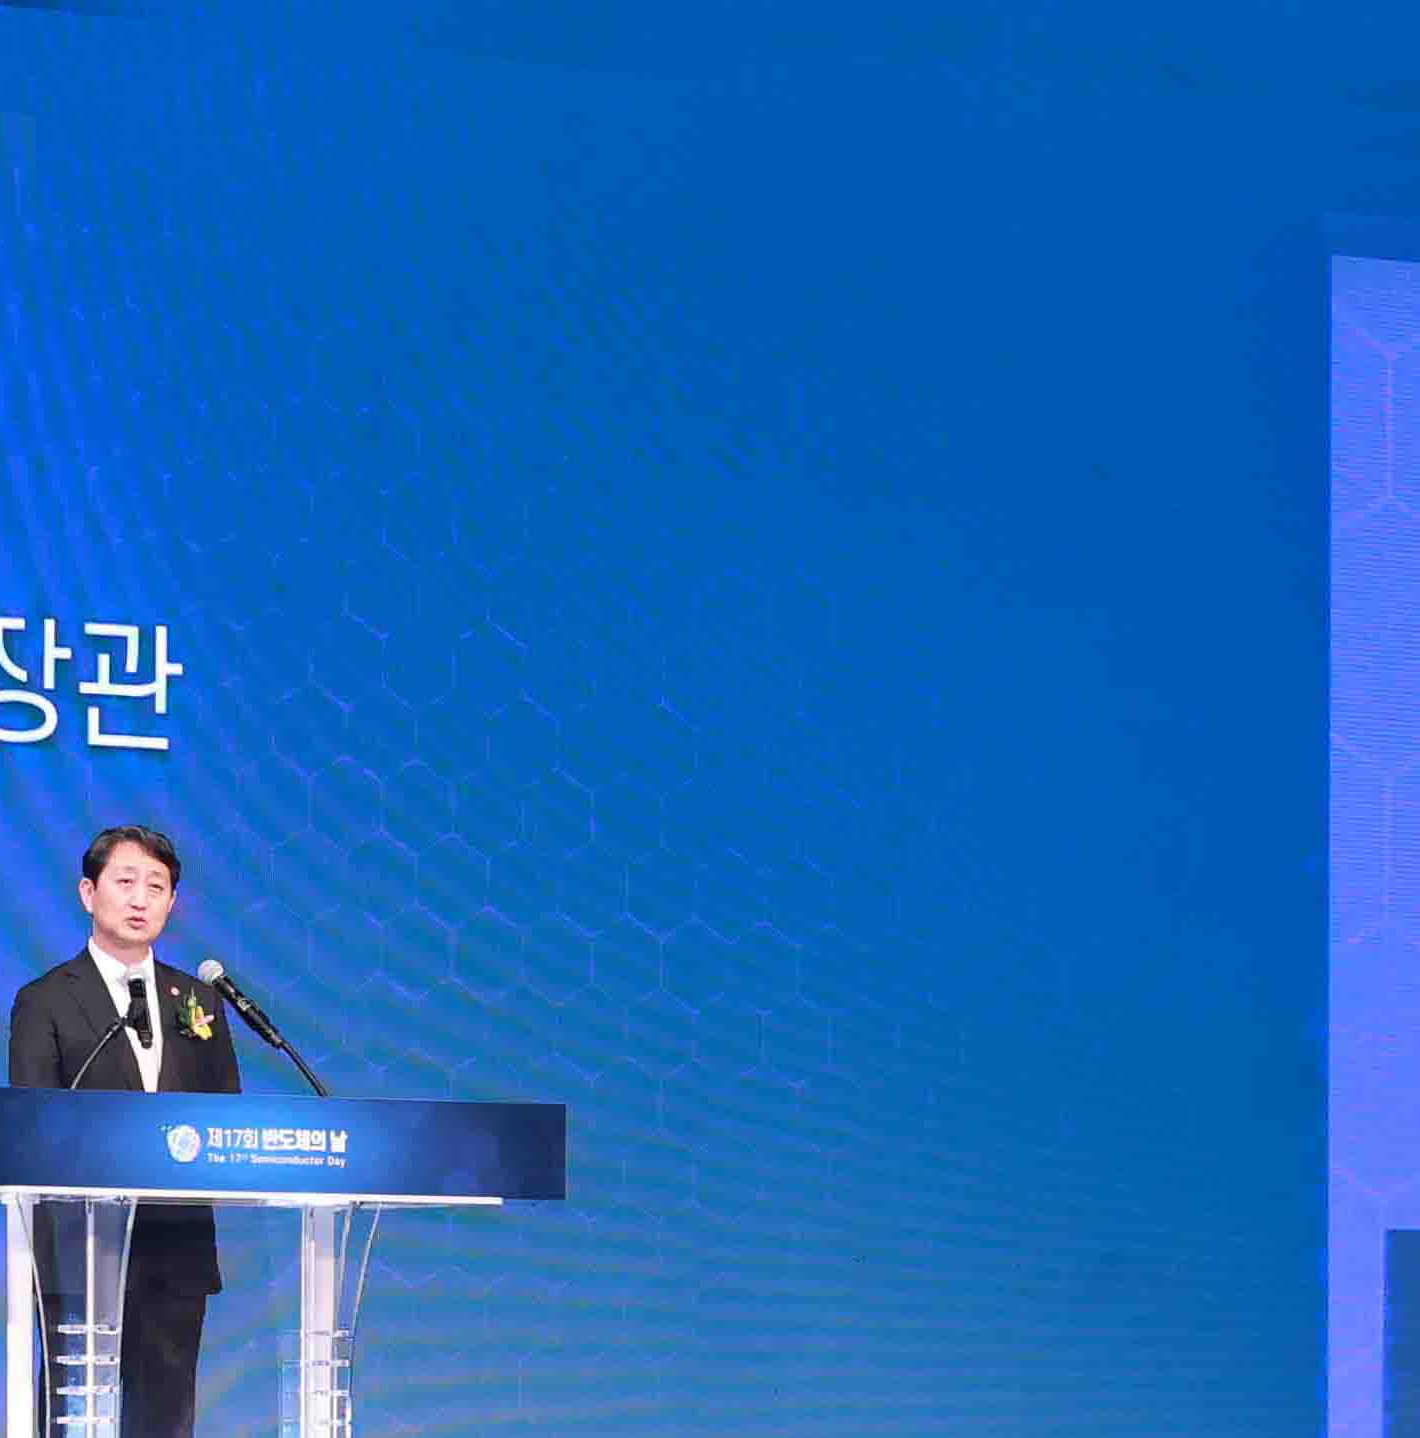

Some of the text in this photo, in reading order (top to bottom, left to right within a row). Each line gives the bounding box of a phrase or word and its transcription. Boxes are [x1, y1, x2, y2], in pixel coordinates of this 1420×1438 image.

[207, 1127, 348, 1153] 제17회 반도체의 날
